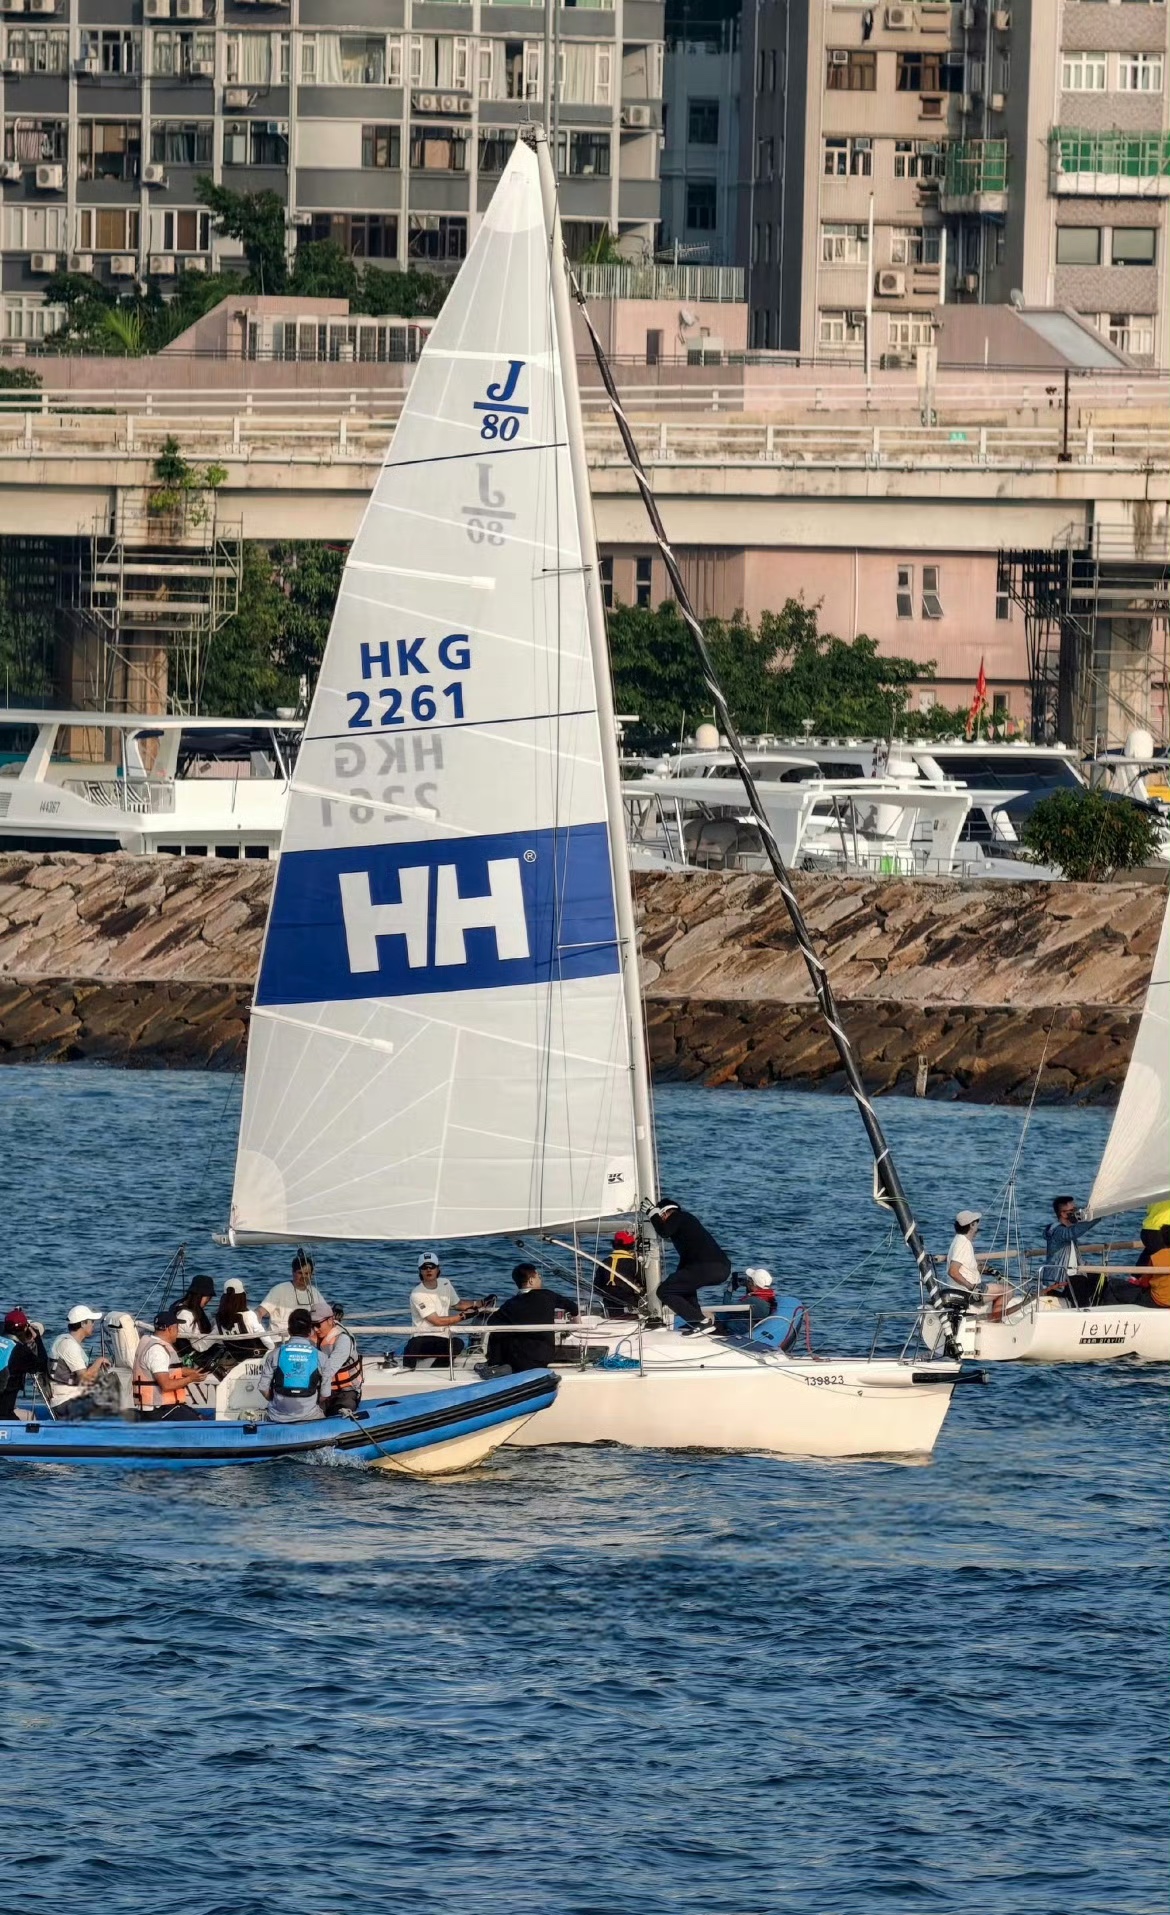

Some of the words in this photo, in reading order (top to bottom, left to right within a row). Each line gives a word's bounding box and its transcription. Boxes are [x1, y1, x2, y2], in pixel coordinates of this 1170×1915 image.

[486, 359, 526, 402] J
[480, 414, 520, 442] 80
[360, 633, 472, 680] HKG
[346, 681, 465, 729] 2261
[338, 857, 531, 974] HH
[1081, 1320, 1141, 1339] levity
[804, 1374, 845, 1387] 139823
